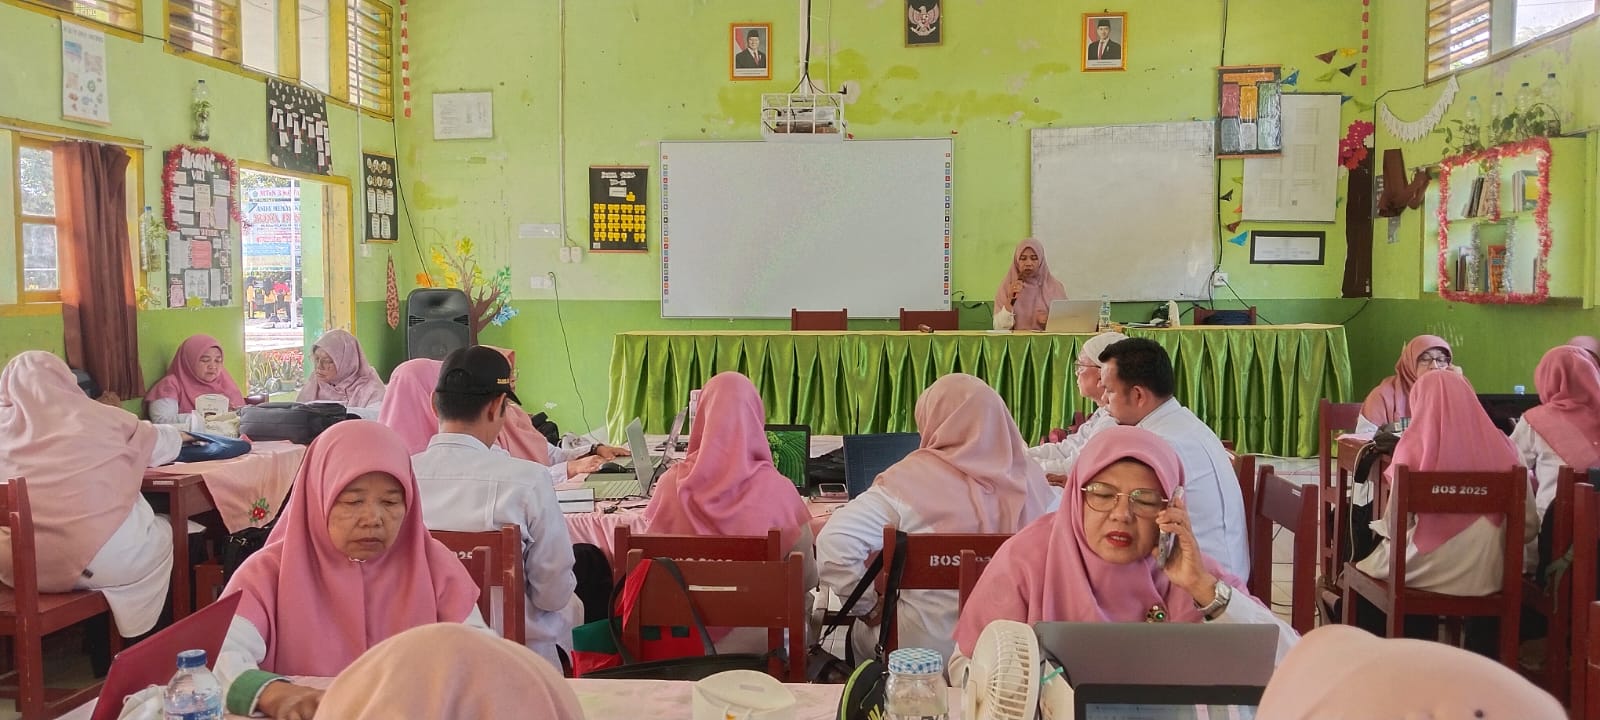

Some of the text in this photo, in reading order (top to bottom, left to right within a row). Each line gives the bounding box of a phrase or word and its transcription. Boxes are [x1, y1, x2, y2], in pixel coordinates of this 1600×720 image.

[1432, 485, 1488, 495] BOS 2025
[930, 555, 961, 567] BOS
